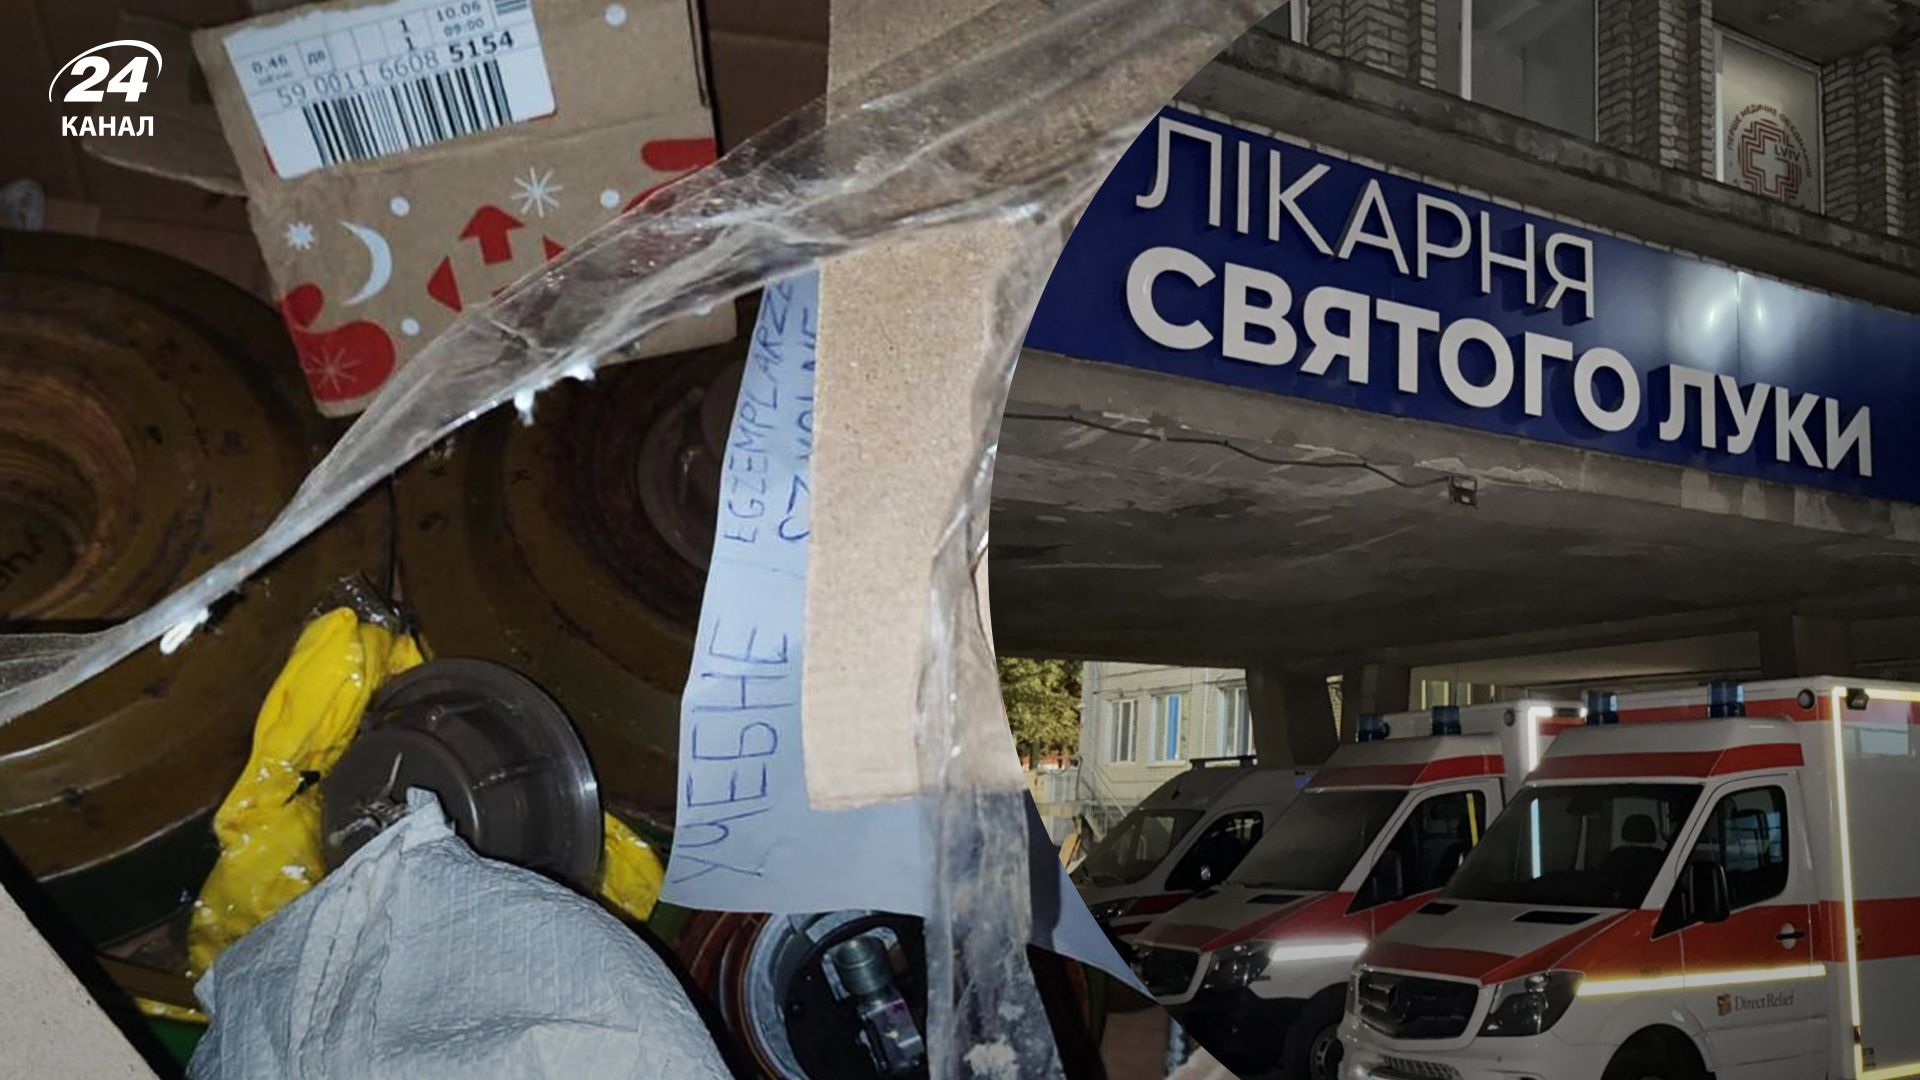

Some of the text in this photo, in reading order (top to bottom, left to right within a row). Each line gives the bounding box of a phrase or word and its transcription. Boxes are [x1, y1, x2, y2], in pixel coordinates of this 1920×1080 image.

[401, 18, 409, 33] 1
[405, 36, 415, 51] 1
[277, 83, 306, 107] 59
[314, 69, 369, 97] 0011
[379, 50, 439, 81] 6608
[449, 30, 514, 62] 5154
[1774, 144, 1801, 162] LVIV
[1136, 116, 1595, 318] ЛІКАРНЯ
[1126, 246, 1873, 478] СВЯТОГО ЛУКИ
[671, 617, 797, 884] УЧЕБНЕ
[1734, 989, 1795, 1012] Direct Relief
